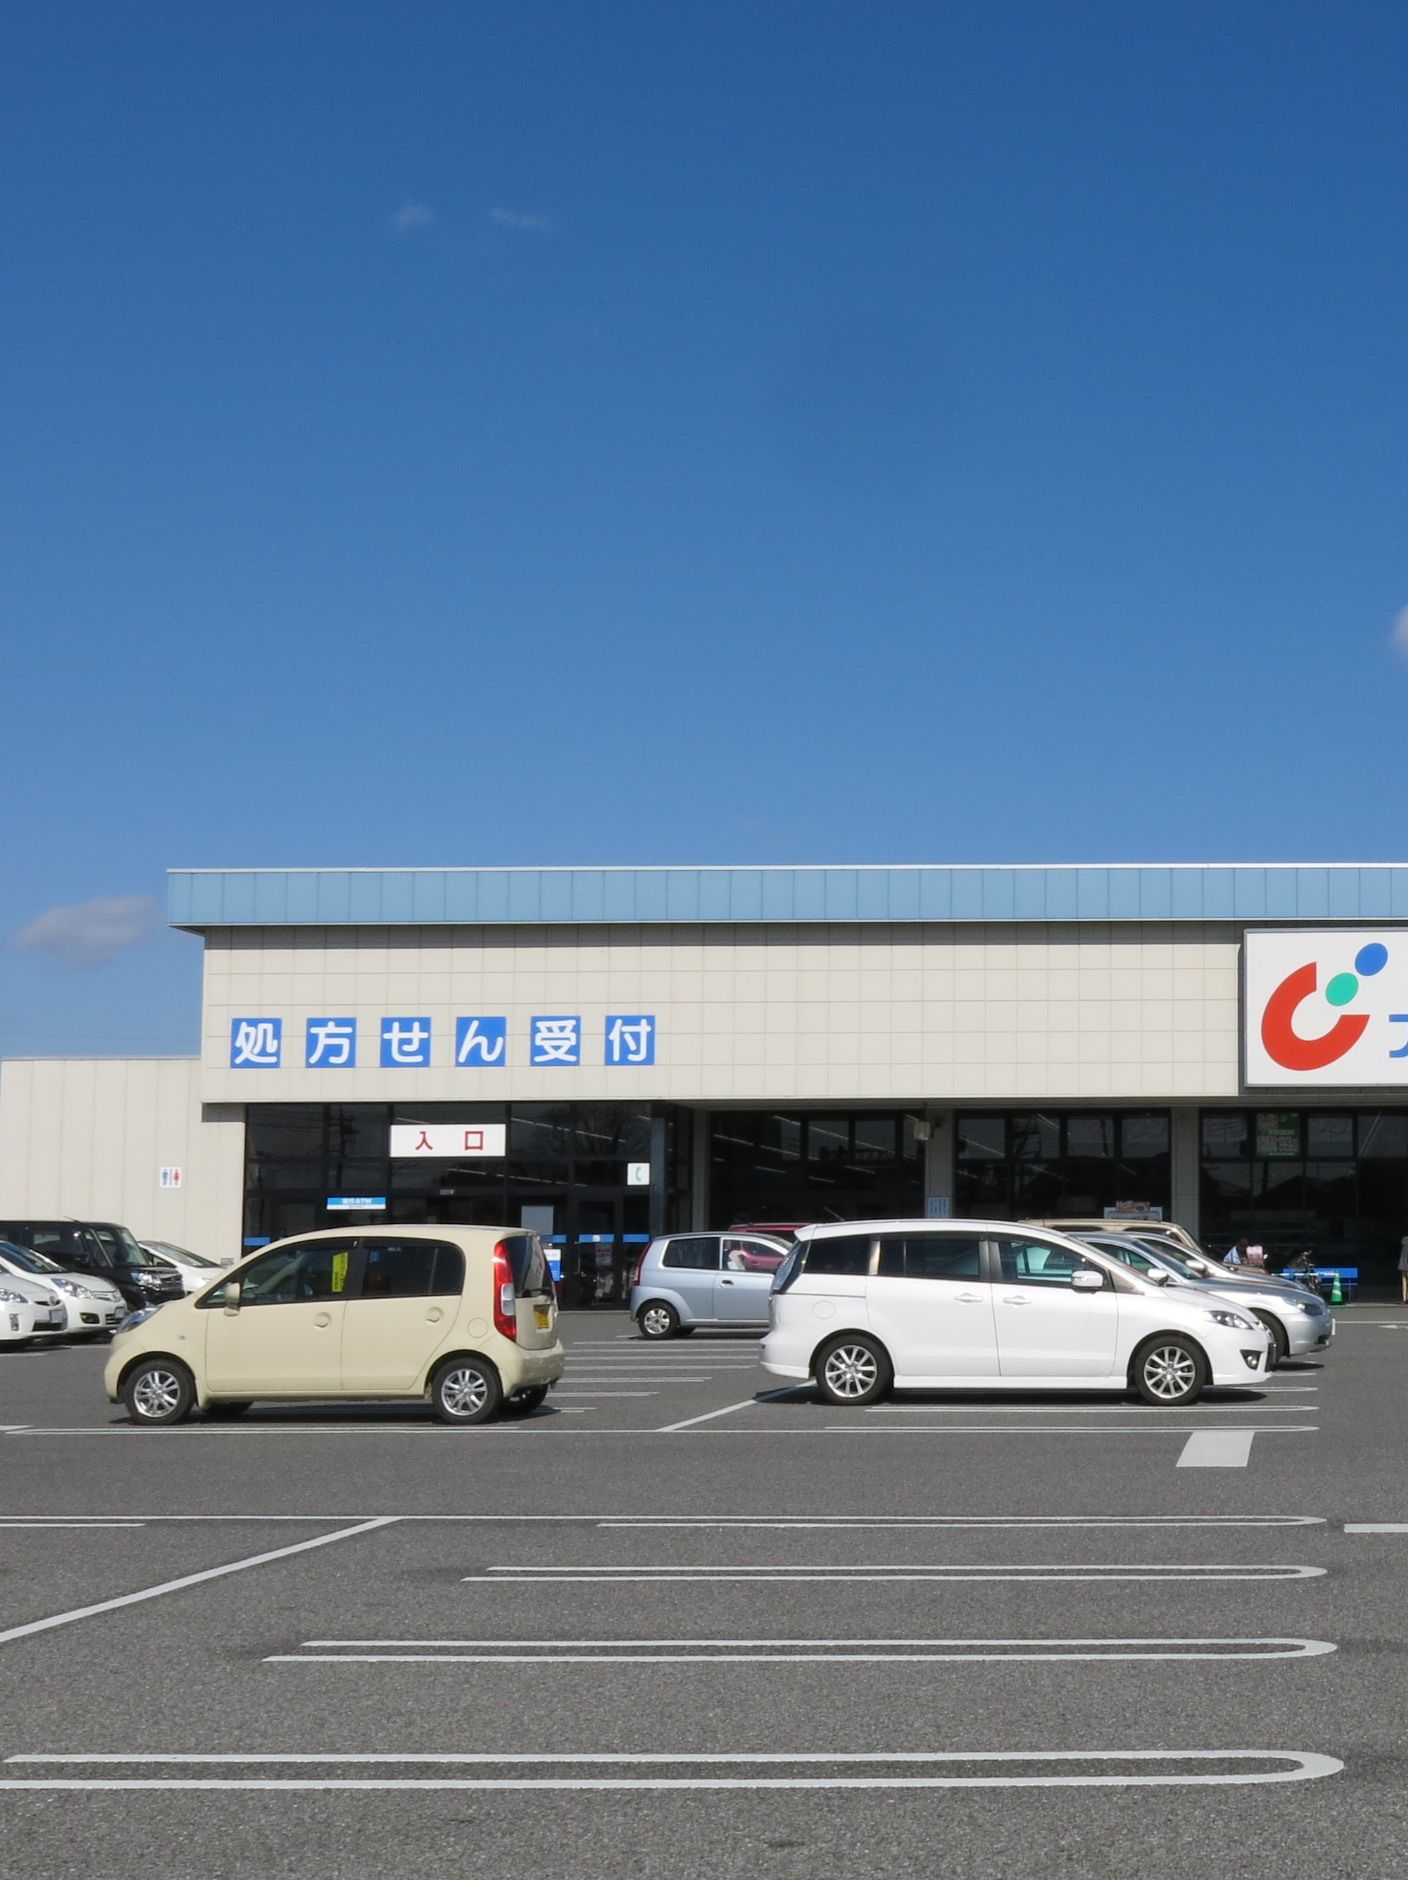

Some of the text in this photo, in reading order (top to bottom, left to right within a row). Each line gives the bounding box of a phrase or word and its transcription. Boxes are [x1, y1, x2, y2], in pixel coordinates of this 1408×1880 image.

[234, 1019, 652, 1064] 処方せん受付
[415, 1130, 484, 1151] 入口
